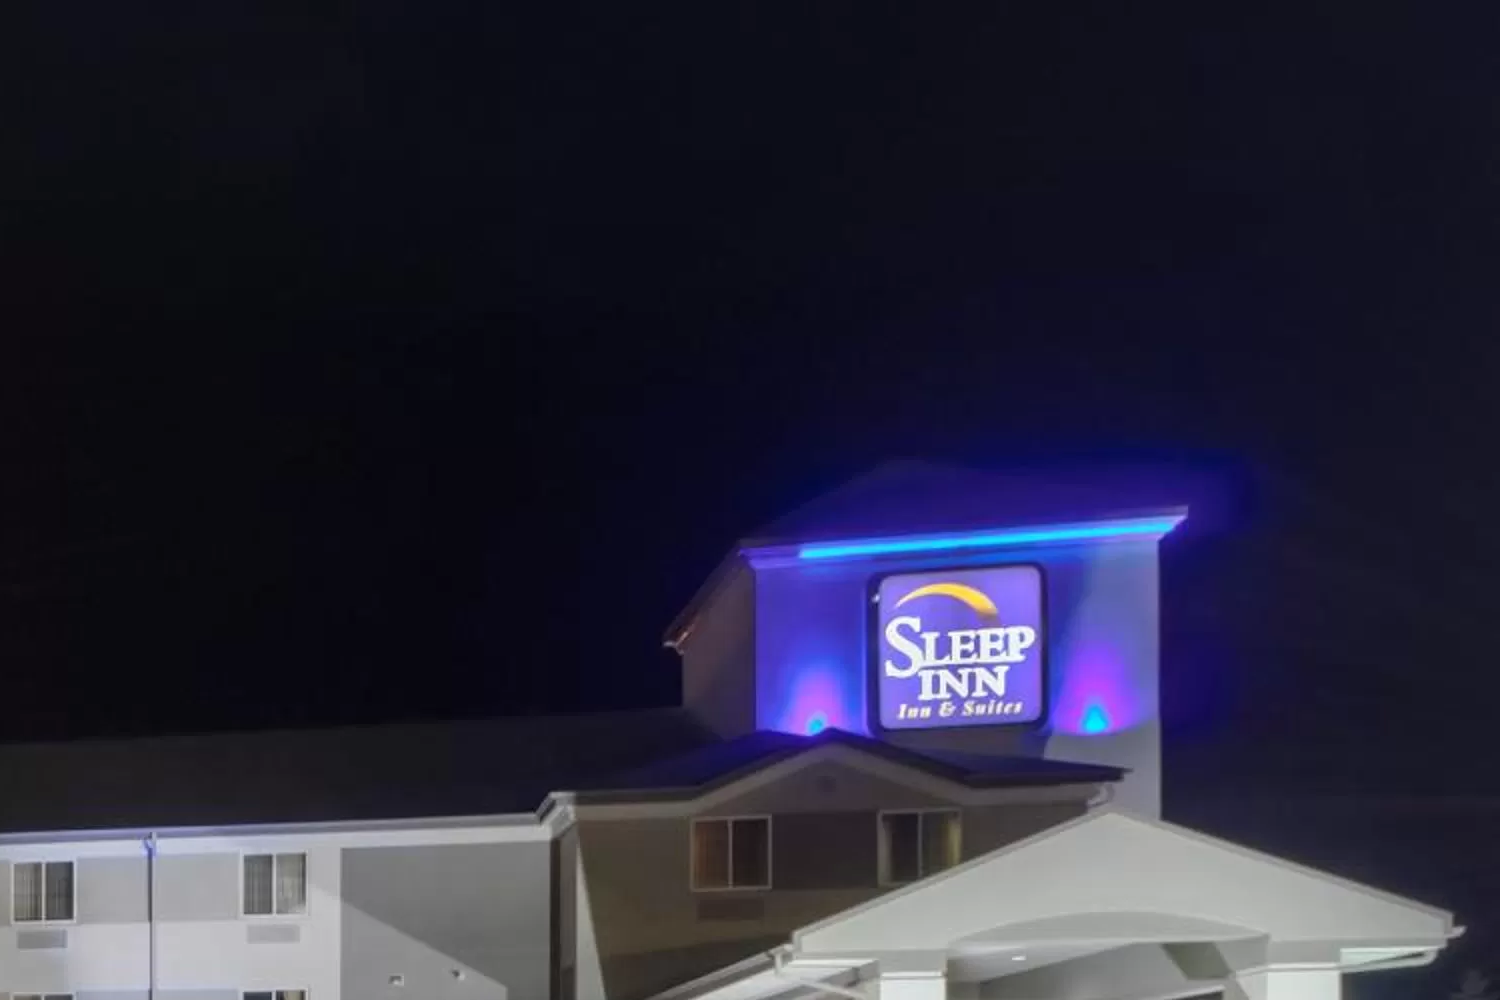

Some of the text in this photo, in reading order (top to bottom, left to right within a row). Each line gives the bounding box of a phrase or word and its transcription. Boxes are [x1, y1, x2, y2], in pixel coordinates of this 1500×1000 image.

[884, 615, 1036, 679] SLEEP
[917, 665, 1010, 701] INN
[897, 699, 1023, 720] Inn & Suites
